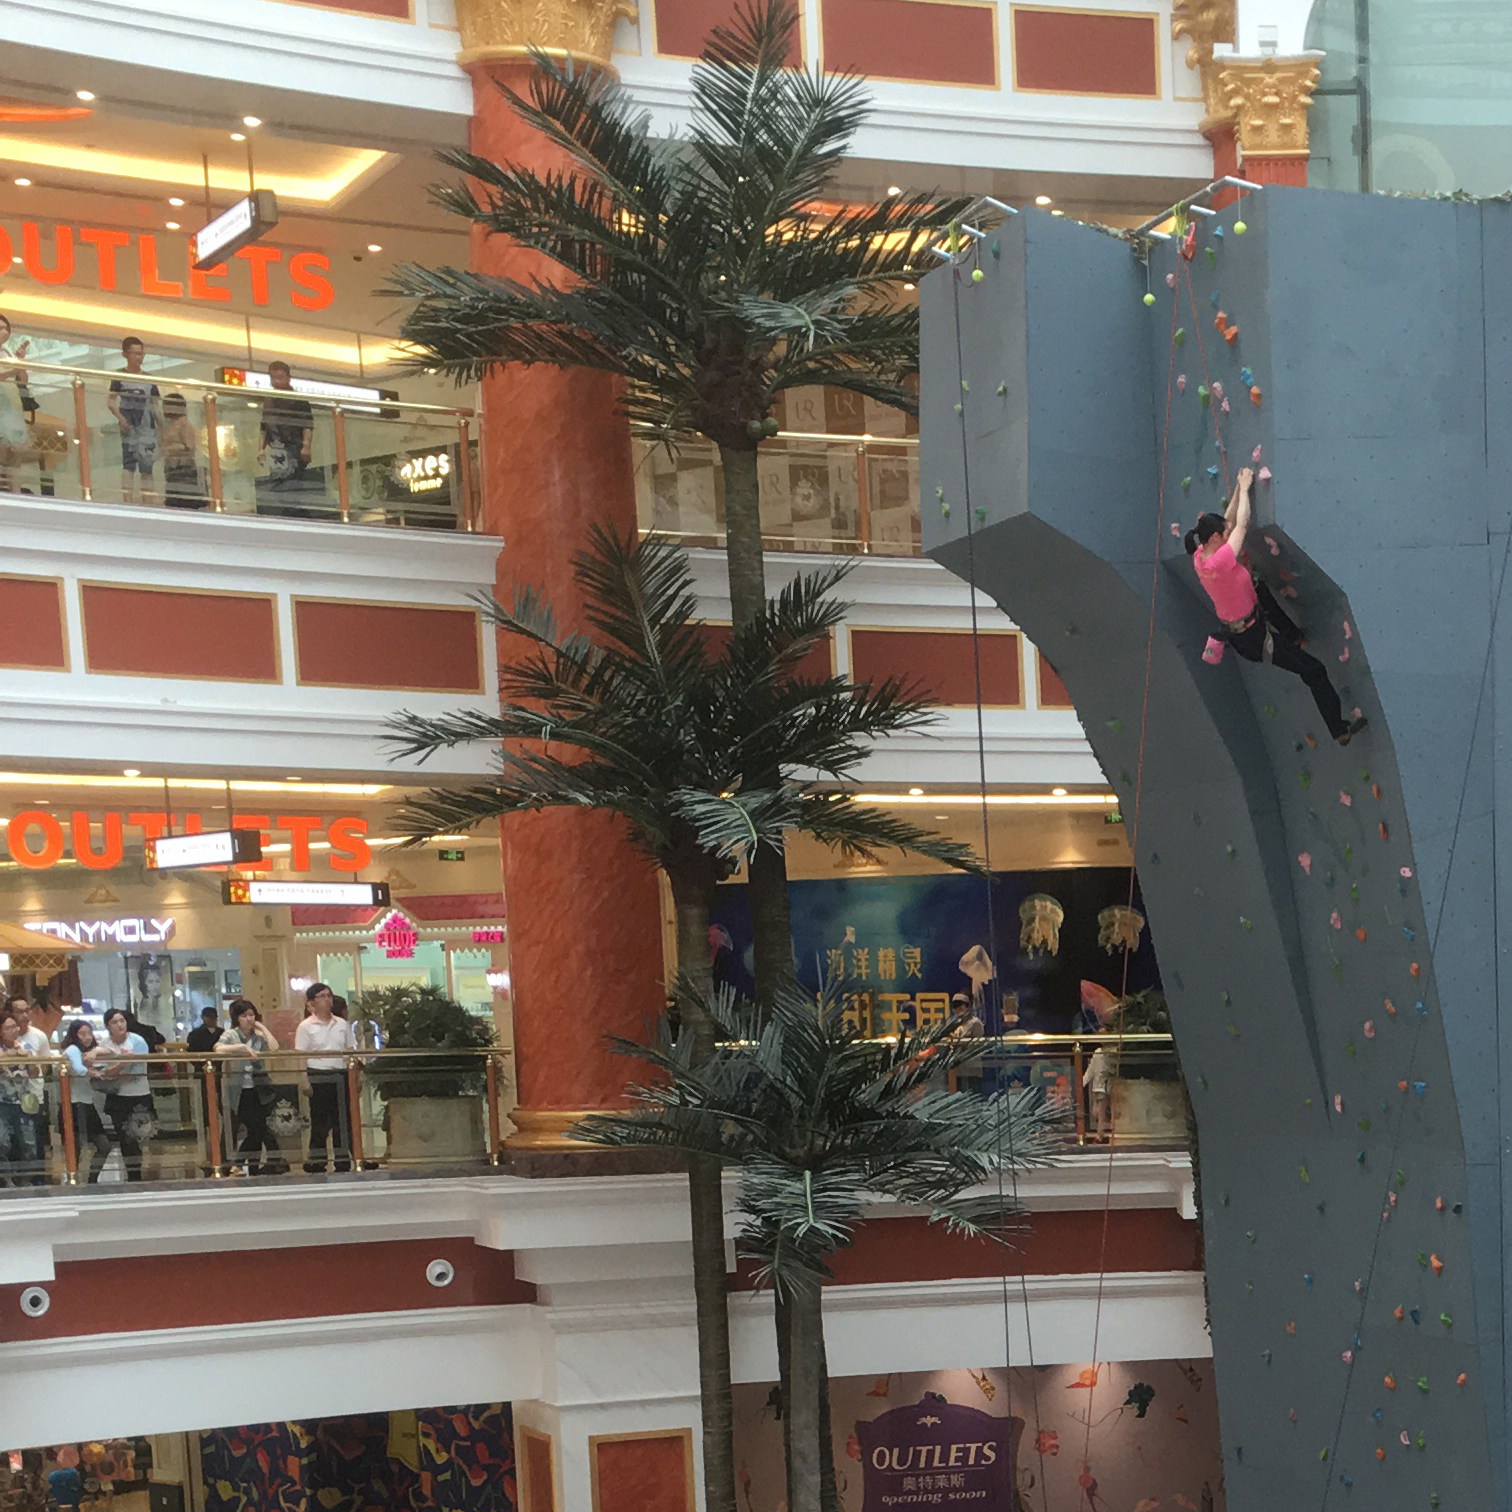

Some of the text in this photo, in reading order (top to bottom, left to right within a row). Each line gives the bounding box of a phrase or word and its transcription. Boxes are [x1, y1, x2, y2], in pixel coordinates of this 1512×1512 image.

[0, 221, 336, 312] UTLETS
[7, 810, 372, 872] OUTETS
[872, 1441, 997, 1470] OUTLETS
[902, 1473, 965, 1491] 奥特莱斯
[882, 1490, 986, 1506] opening soon
